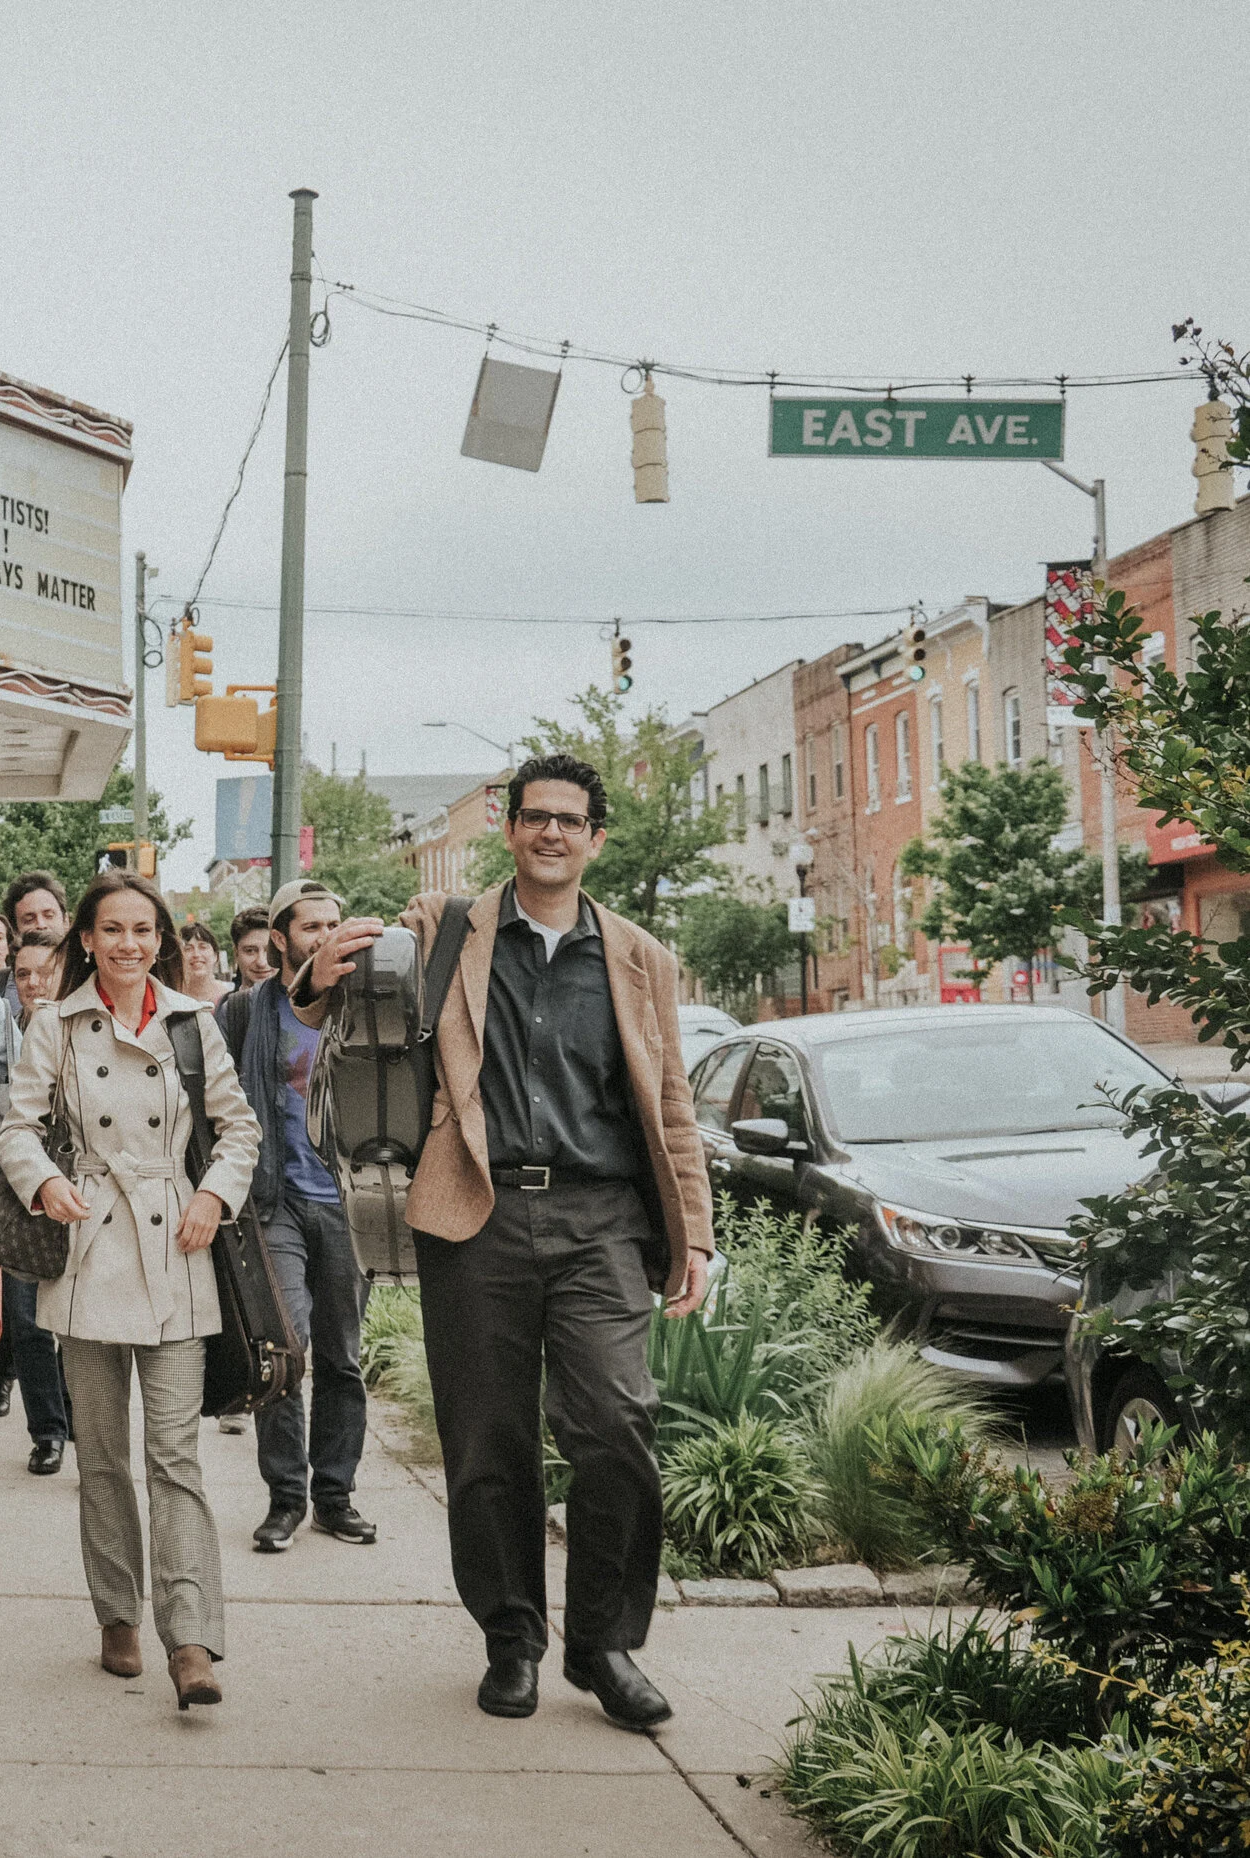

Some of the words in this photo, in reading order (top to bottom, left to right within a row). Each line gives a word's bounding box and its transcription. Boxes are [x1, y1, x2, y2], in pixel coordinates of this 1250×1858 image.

[802, 408, 927, 448] EAST
[946, 413, 1039, 446] AVE.
[37, 571, 96, 612] MATTER
